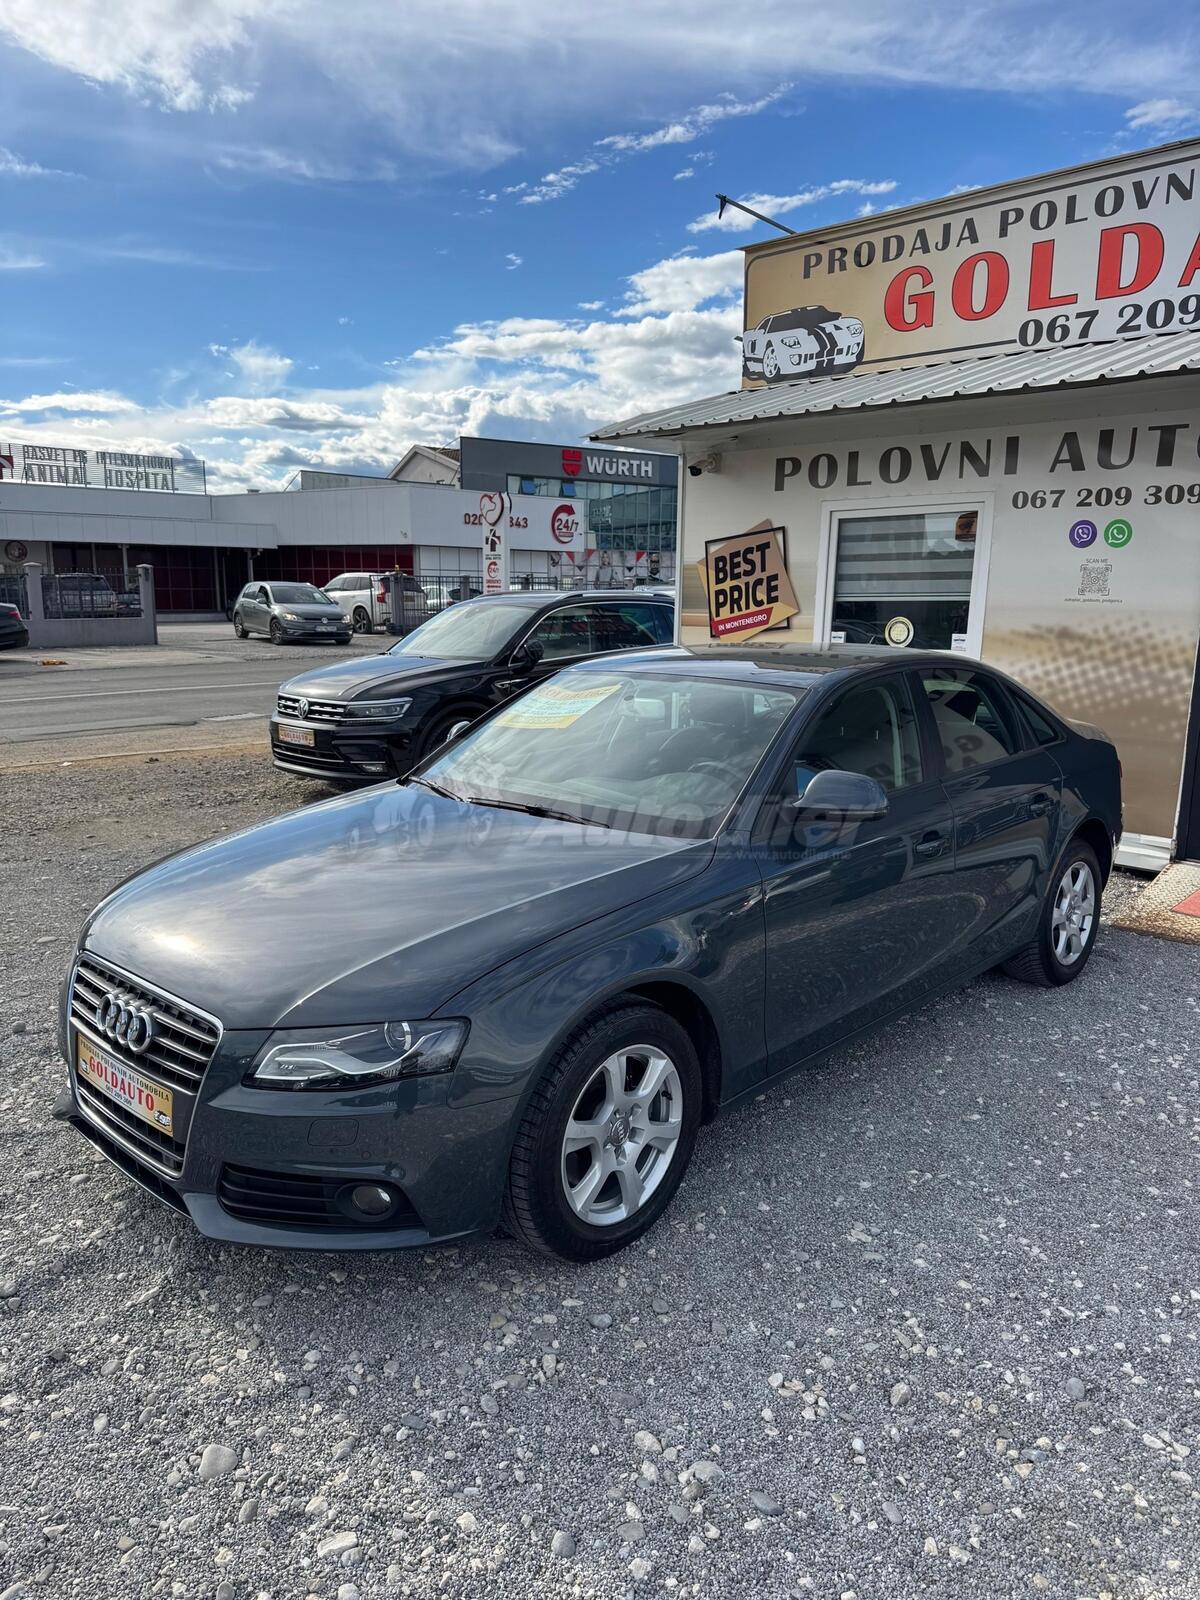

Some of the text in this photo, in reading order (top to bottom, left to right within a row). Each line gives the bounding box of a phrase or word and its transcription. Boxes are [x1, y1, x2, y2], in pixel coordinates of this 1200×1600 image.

[803, 168, 1195, 279] PRODAJA POLOVN
[884, 222, 1200, 332] GOLD
[1018, 294, 1200, 347] 067 209
[25, 462, 178, 491] ANIMAL HOSPITAL
[587, 455, 653, 478] WÜRTH
[774, 423, 1200, 491] POLOVNI AUT
[1012, 483, 1200, 510] 067 209 309
[556, 518, 579, 532] 24/7
[714, 541, 770, 586] BEST
[714, 573, 779, 618] PRICE
[726, 613, 768, 630] MONTENEGRO
[89, 1055, 154, 1111] GOLDAUTO
